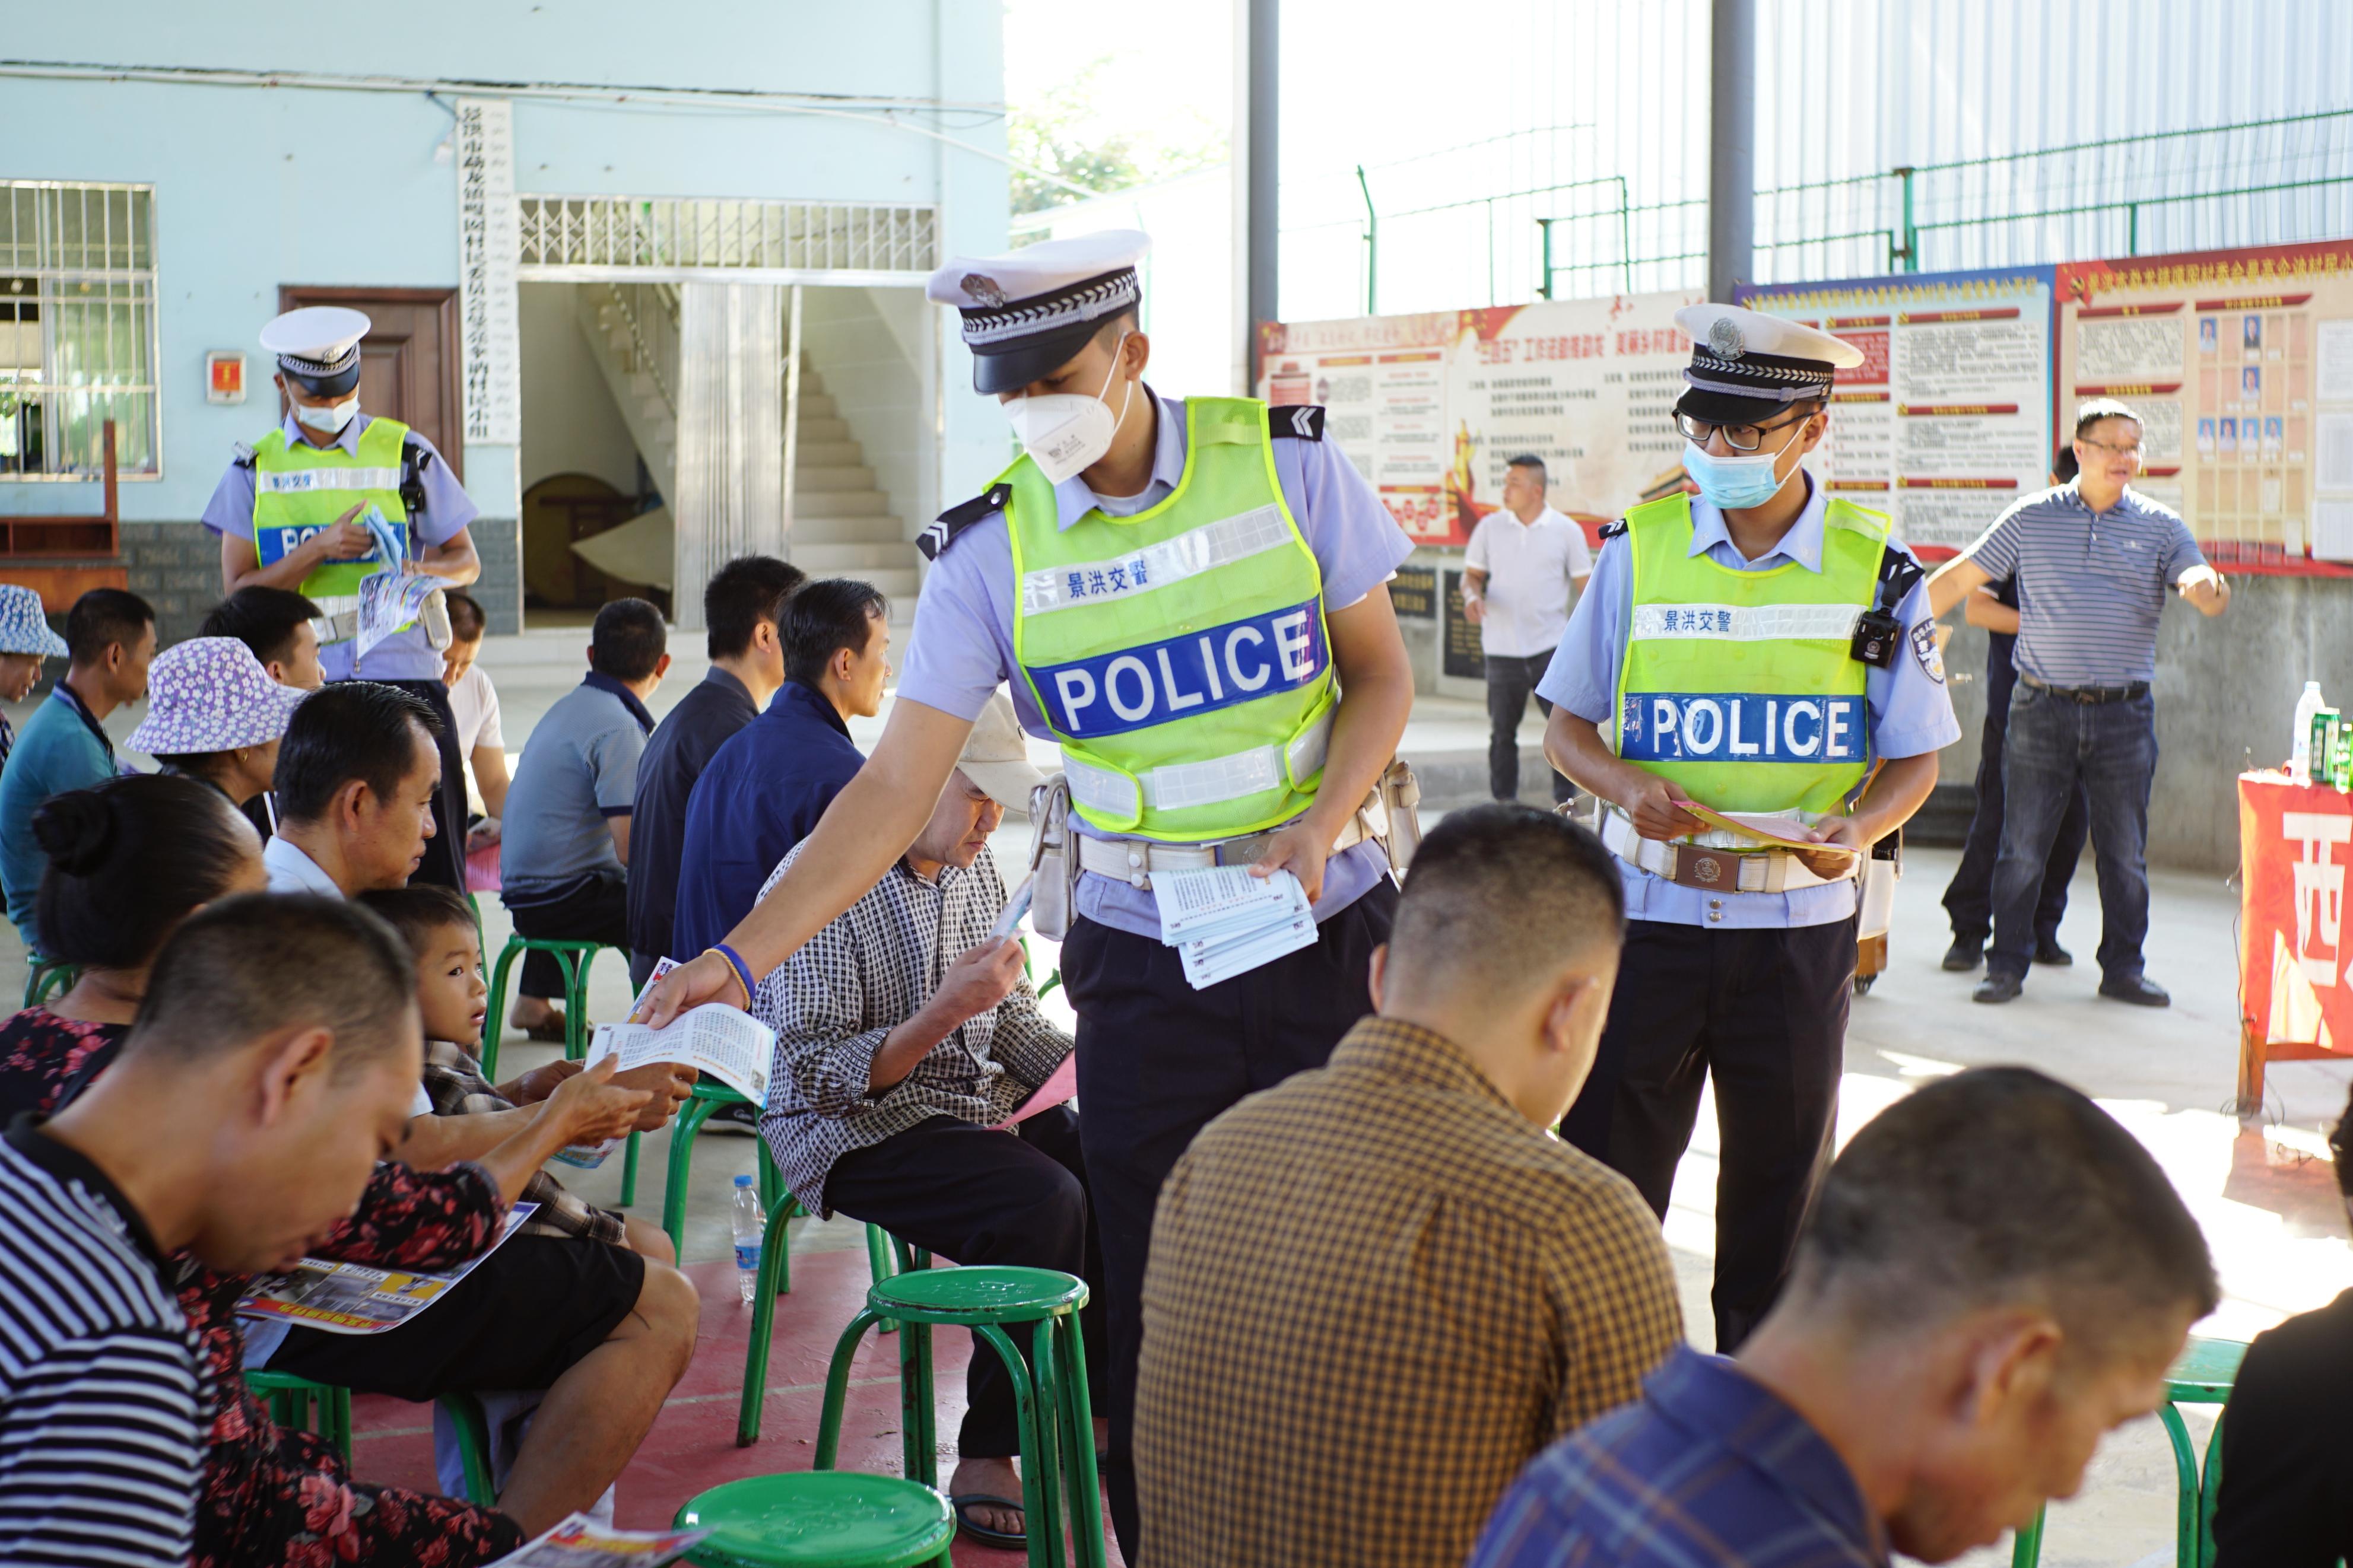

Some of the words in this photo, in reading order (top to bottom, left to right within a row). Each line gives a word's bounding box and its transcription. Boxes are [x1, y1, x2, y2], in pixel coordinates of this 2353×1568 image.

[1068, 559, 1147, 598] 景洪交警
[1665, 610, 1731, 632] 景洪交警
[1055, 610, 1314, 731] POLICE
[1653, 699, 1850, 756] POLICE
[2283, 812, 2353, 987] 西
